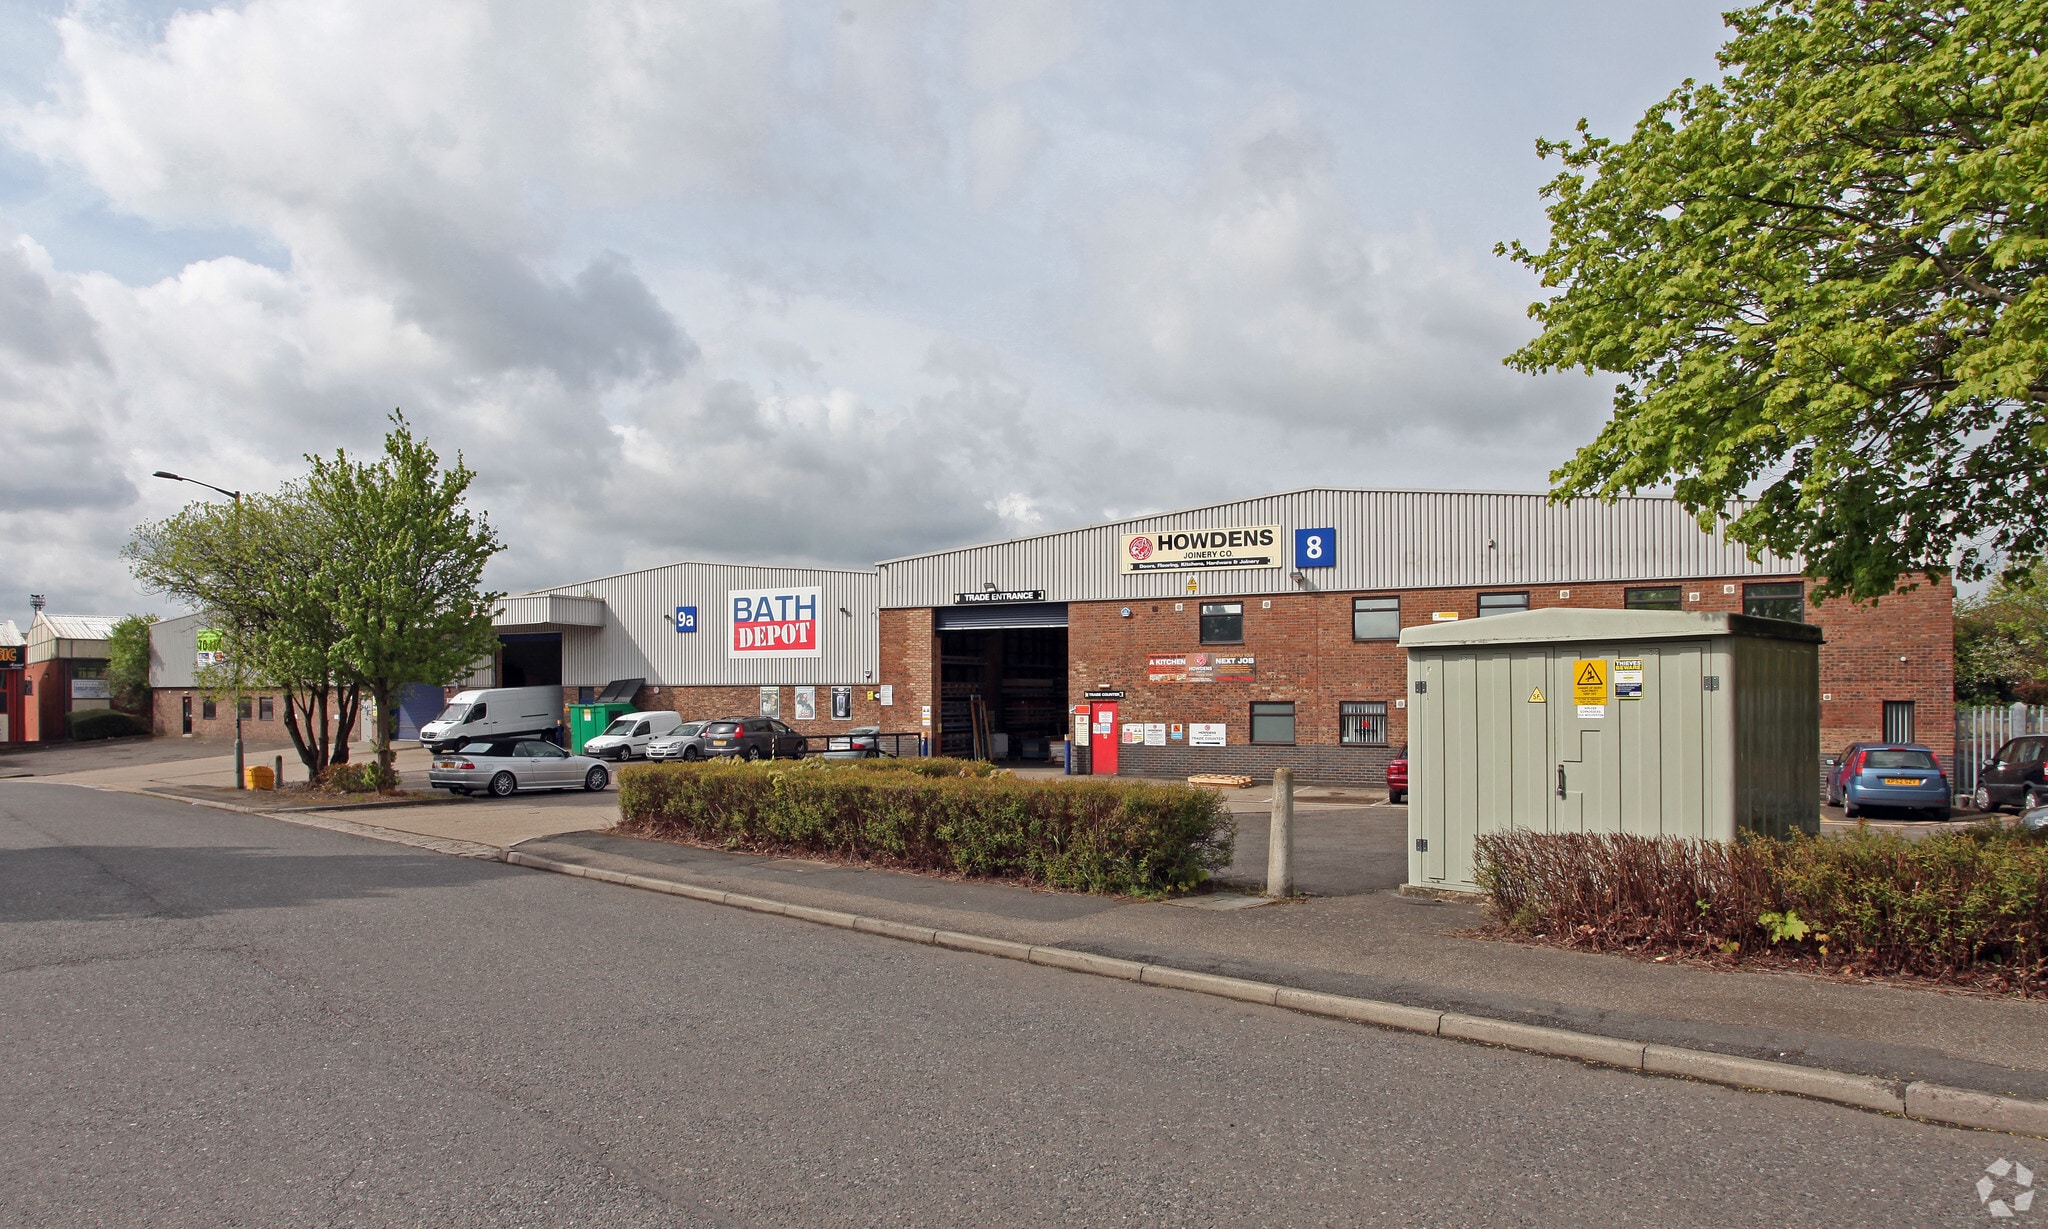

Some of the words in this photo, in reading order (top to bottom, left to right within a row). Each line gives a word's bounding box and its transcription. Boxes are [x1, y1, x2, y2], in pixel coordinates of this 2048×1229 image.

[1158, 529, 1274, 551] HOWDENS
[1306, 535, 1322, 559] 8
[1180, 560, 1205, 568] Kitchens,
[1239, 558, 1260, 566] Joinery
[1183, 551, 1219, 560] JOINERY
[1220, 550, 1234, 558] CO.
[964, 594, 990, 602] TRADE
[991, 591, 1034, 601] ENTRANCE
[733, 594, 816, 623] BATH
[677, 611, 694, 627] 9a
[738, 621, 811, 648] DEPOT
